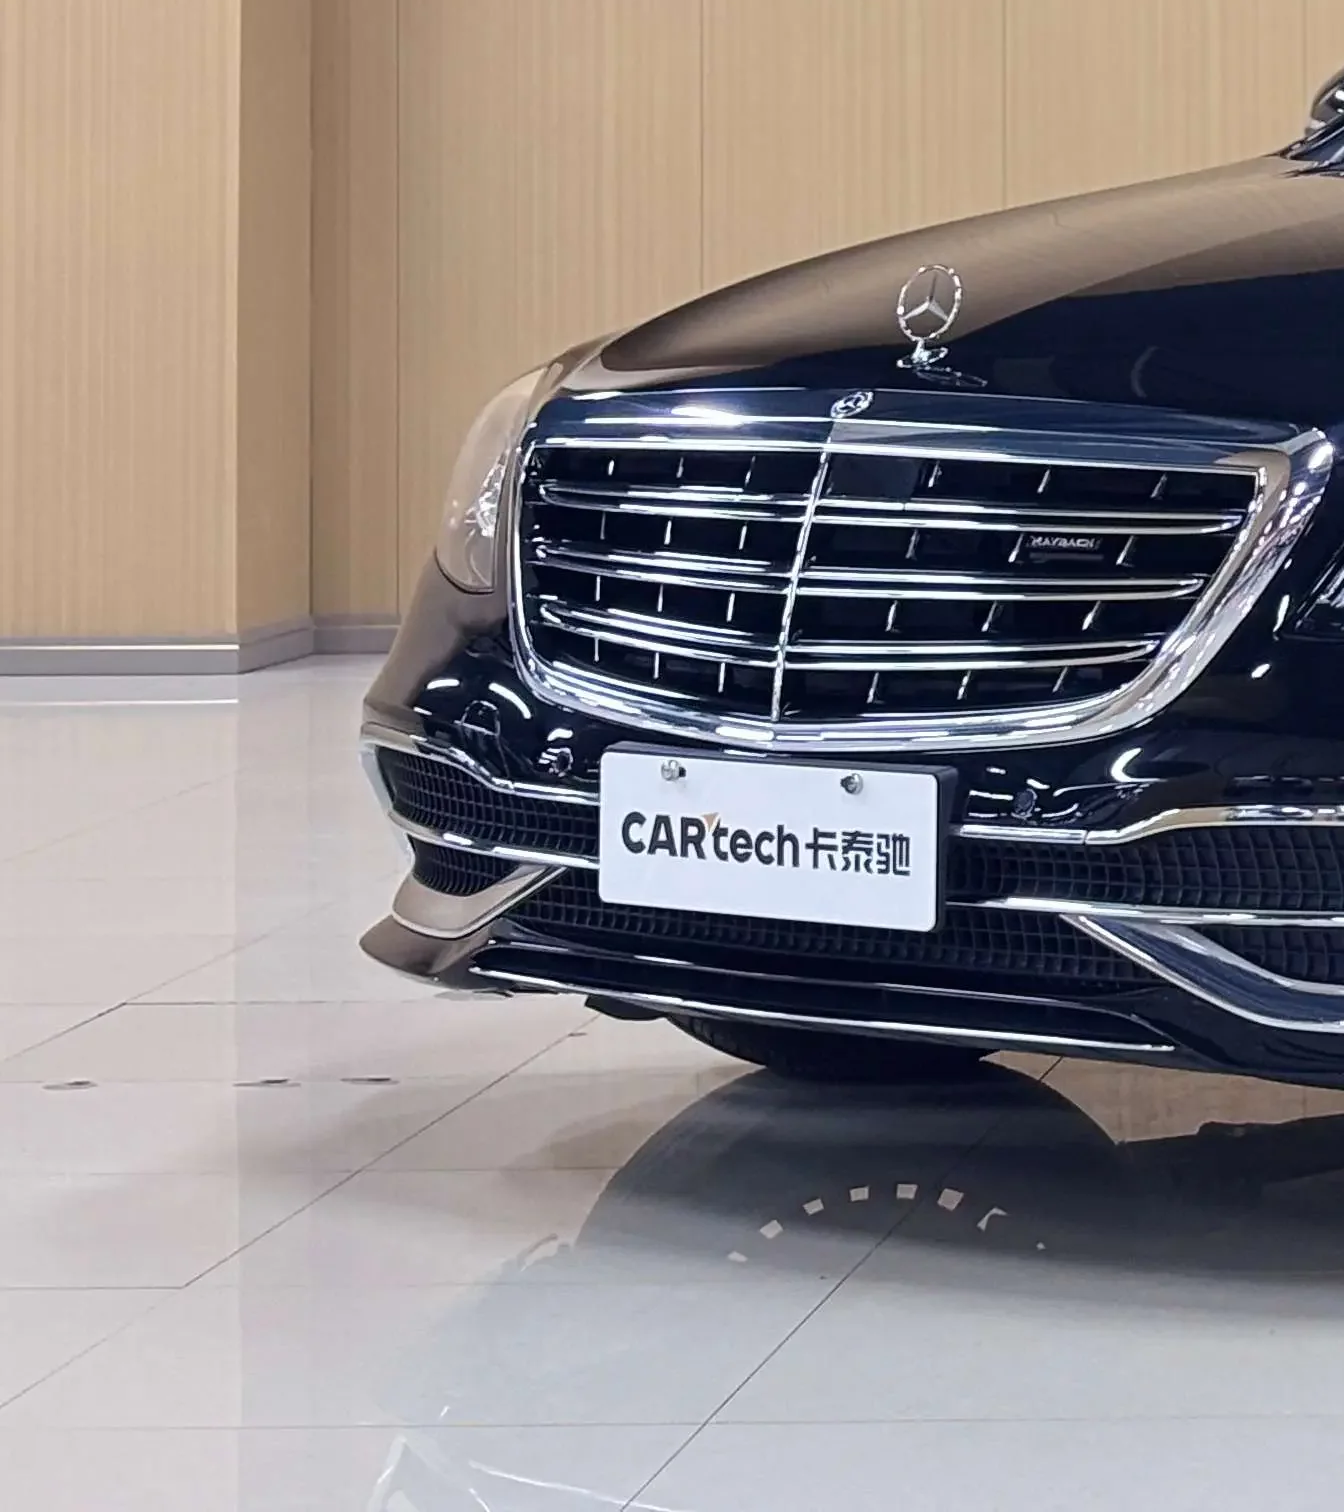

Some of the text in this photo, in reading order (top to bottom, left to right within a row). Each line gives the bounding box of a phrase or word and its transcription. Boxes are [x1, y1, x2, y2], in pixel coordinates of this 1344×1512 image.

[621, 811, 911, 877] CARtech 卡泰驰
